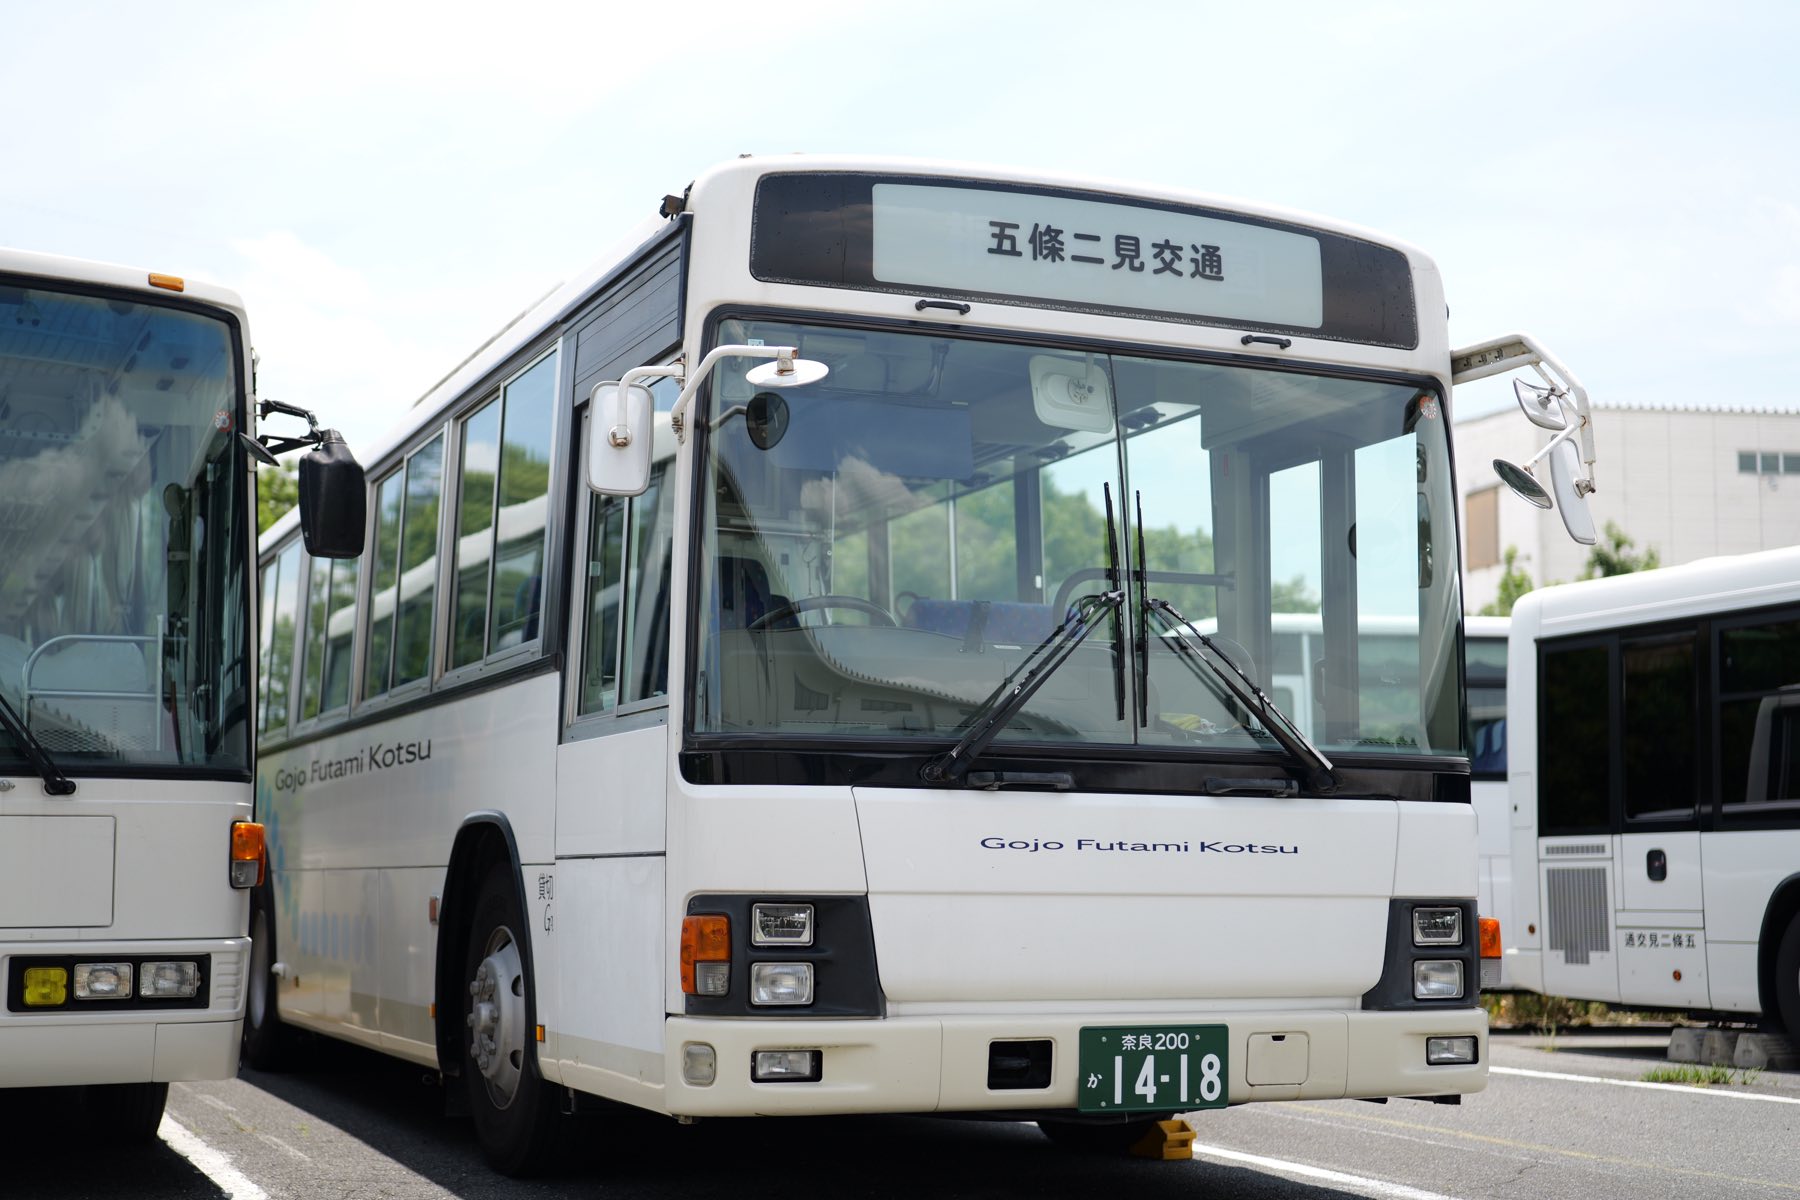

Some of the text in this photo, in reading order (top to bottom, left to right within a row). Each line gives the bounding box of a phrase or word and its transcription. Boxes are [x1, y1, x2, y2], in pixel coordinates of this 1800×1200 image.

[987, 220, 1225, 282] 五條二見交通
[275, 738, 432, 794] Gojo Futami Kotsu
[980, 836, 1299, 854] Gojo Futami Kotsu
[1087, 1072, 1103, 1089] か
[1114, 1053, 1222, 1105] 14-18
